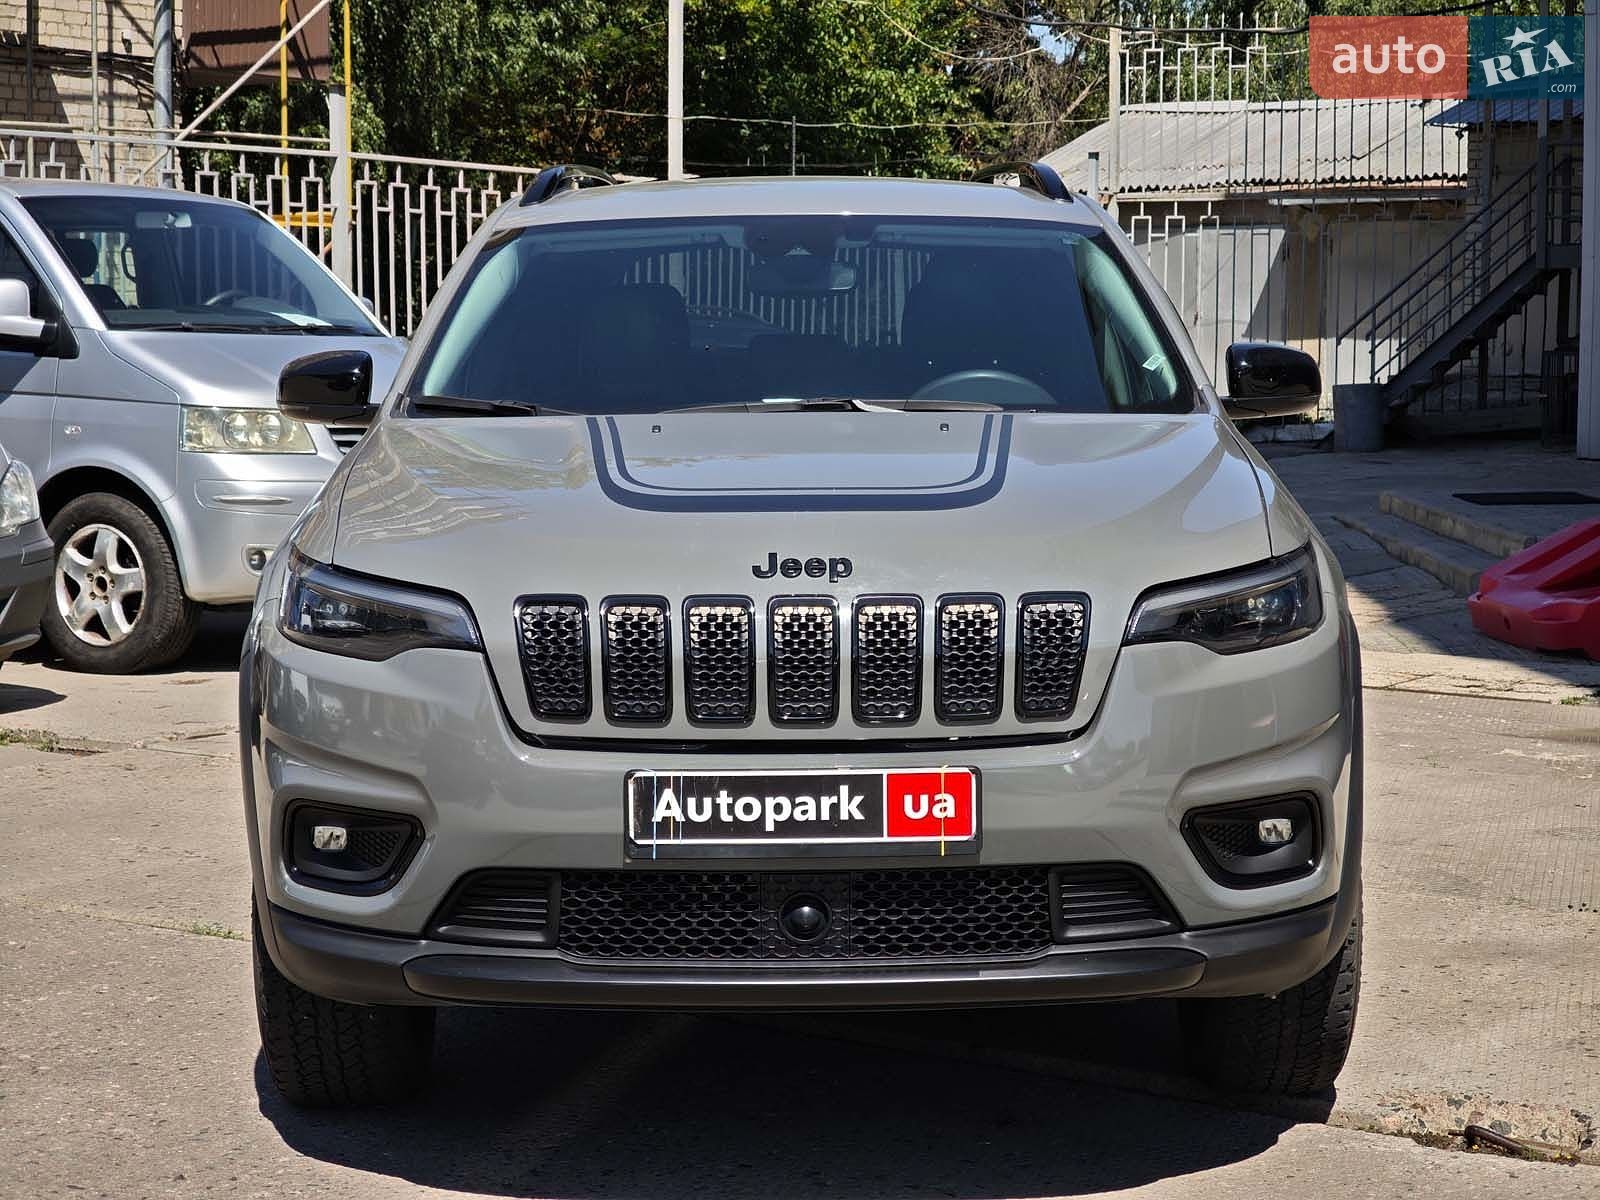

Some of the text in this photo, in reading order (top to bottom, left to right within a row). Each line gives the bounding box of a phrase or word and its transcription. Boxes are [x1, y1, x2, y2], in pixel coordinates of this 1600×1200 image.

[751, 552, 853, 583] Jeep
[651, 785, 956, 832] Autopark ua
